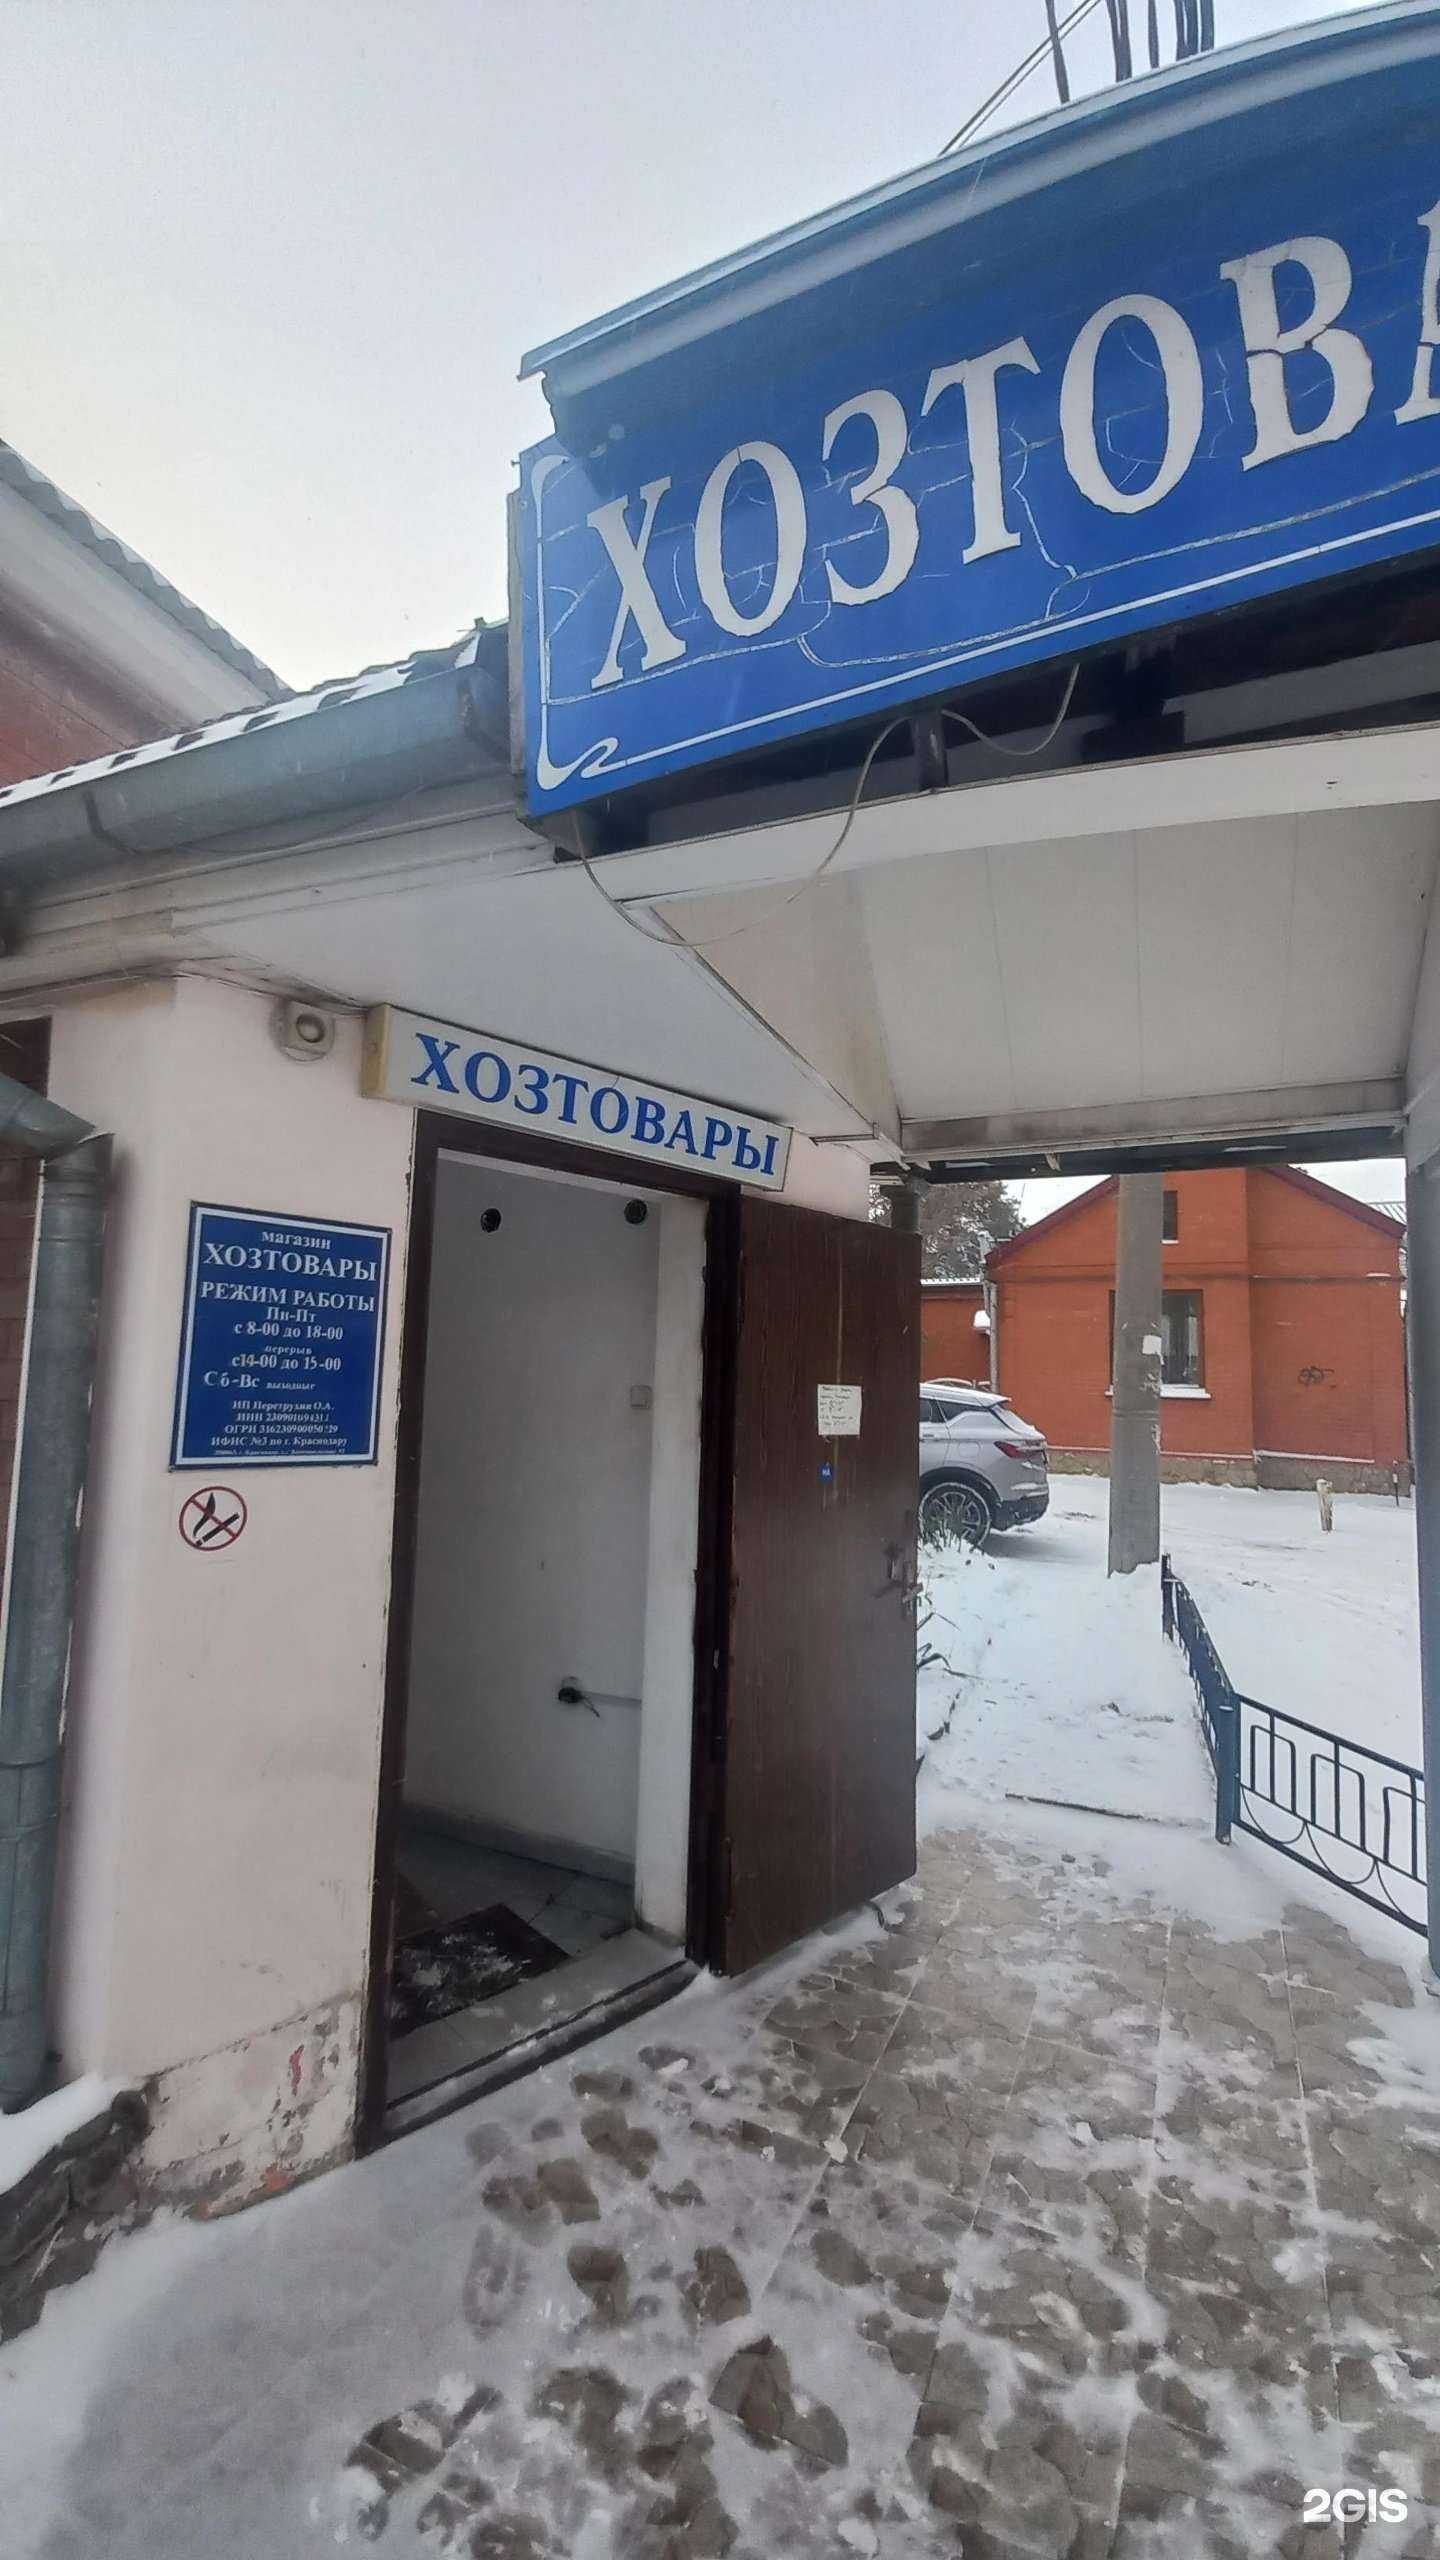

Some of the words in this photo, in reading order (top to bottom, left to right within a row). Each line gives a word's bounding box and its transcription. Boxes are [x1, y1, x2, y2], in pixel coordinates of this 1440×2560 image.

[410, 1032, 780, 1176] ХОЗТОВАРЫ
[261, 1231, 332, 1250] магазин
[203, 1242, 377, 1281] ХОЗТОВАРЫ
[200, 1281, 286, 1305] РЕЖИМ
[293, 1289, 375, 1312] РАБОТЫ
[266, 1307, 316, 1322] Пн-Пт
[234, 1324, 243, 1334] с
[247, 1321, 280, 1337] 8-00
[283, 1326, 301, 1339] до
[306, 1325, 343, 1340] 18-00
[264, 1345, 313, 1355] перерыв
[280, 1359, 299, 1370] до
[304, 1356, 341, 1371] 15-00
